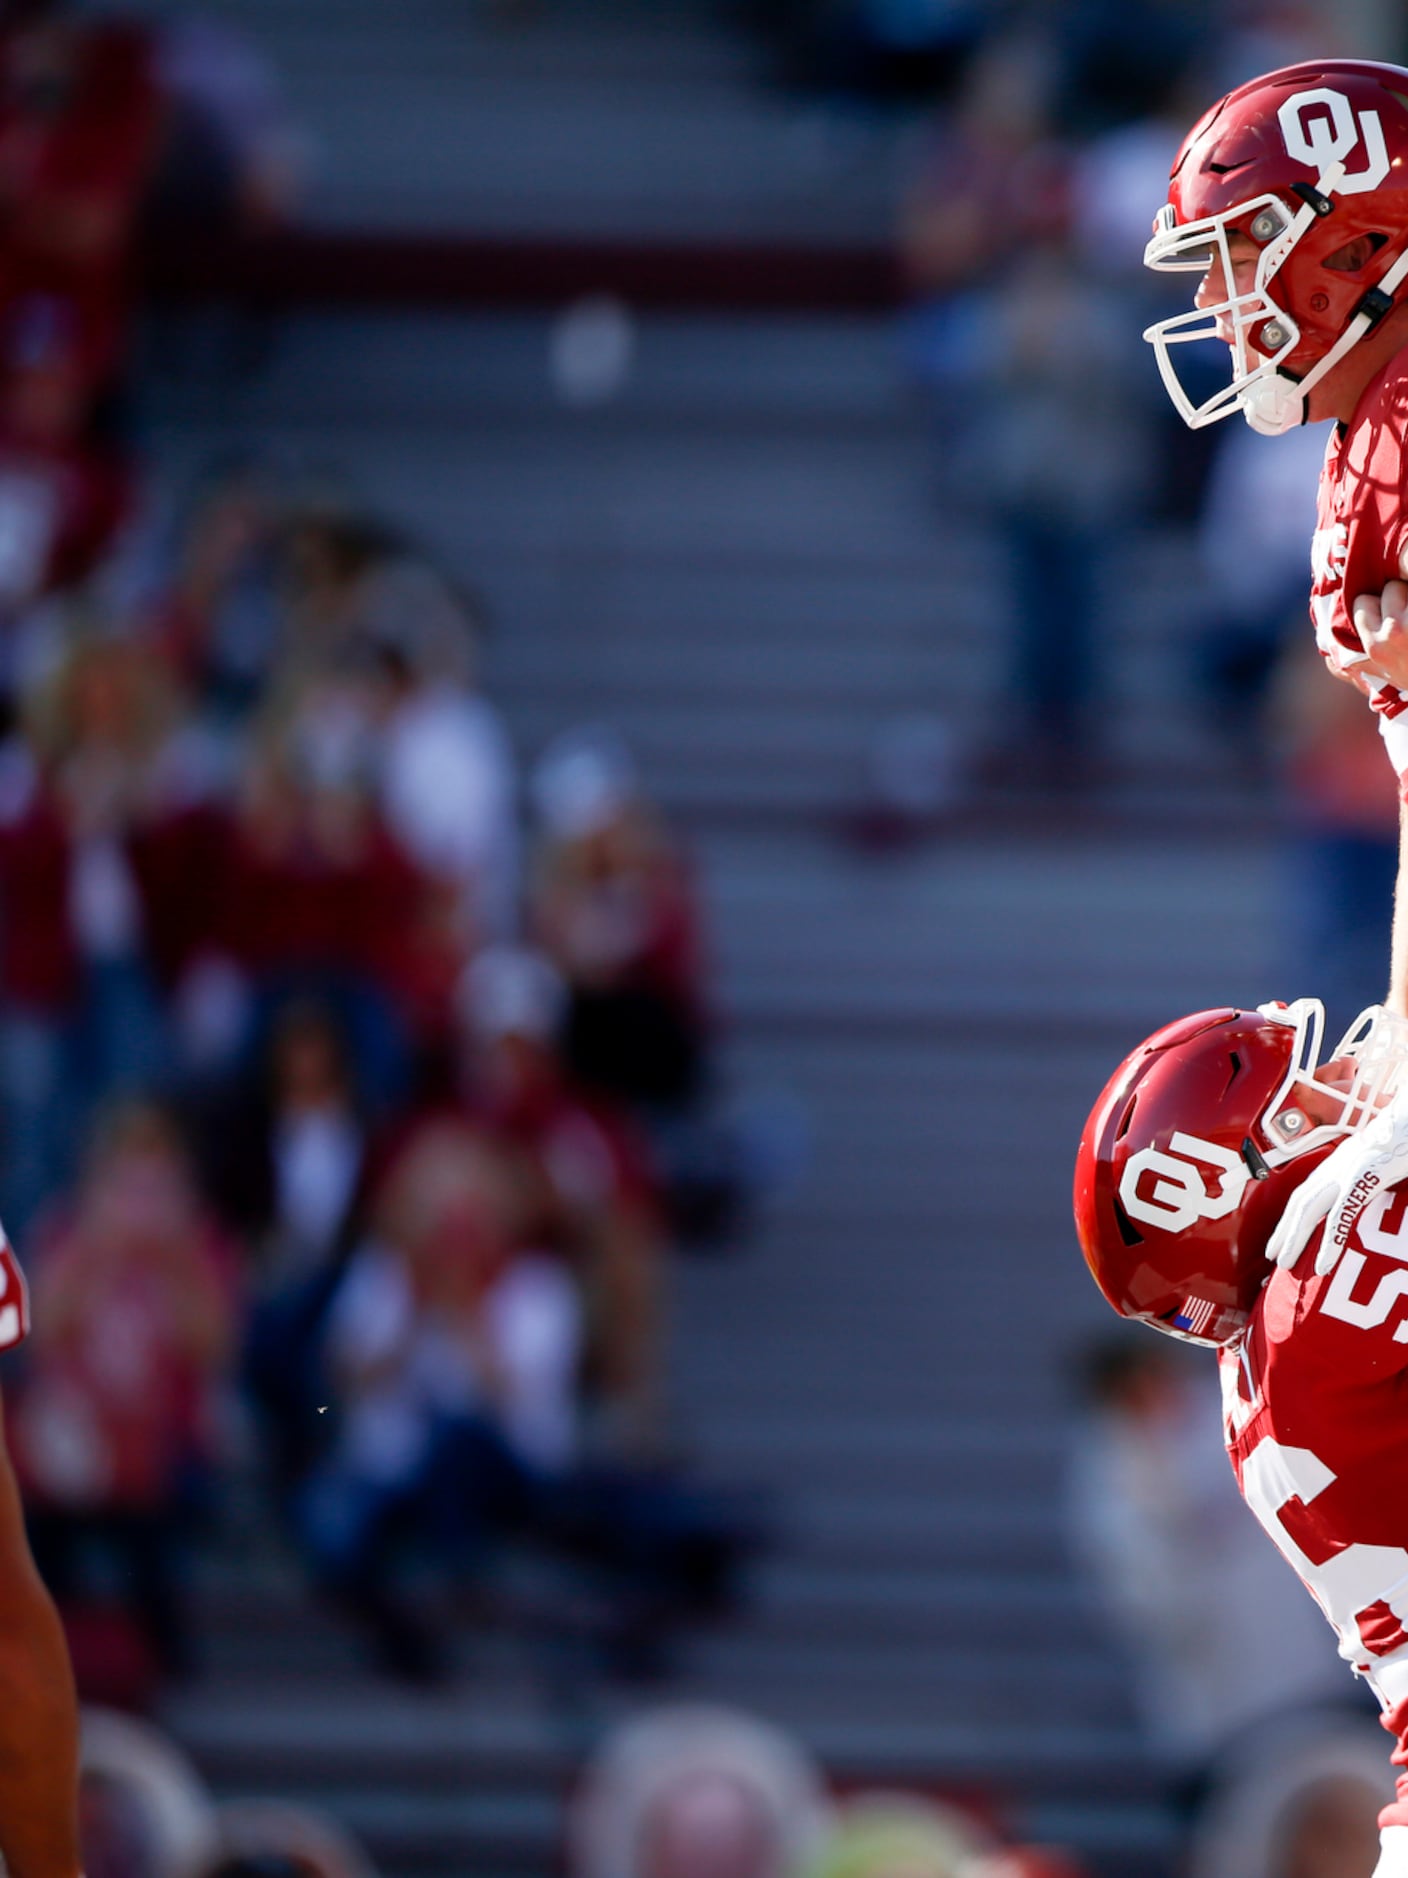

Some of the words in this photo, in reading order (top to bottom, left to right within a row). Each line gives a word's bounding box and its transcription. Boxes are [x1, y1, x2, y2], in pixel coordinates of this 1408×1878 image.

[1277, 87, 1391, 196] OU
[1119, 1132, 1250, 1235] OU
[1334, 1170, 1381, 1247] SOONERS
